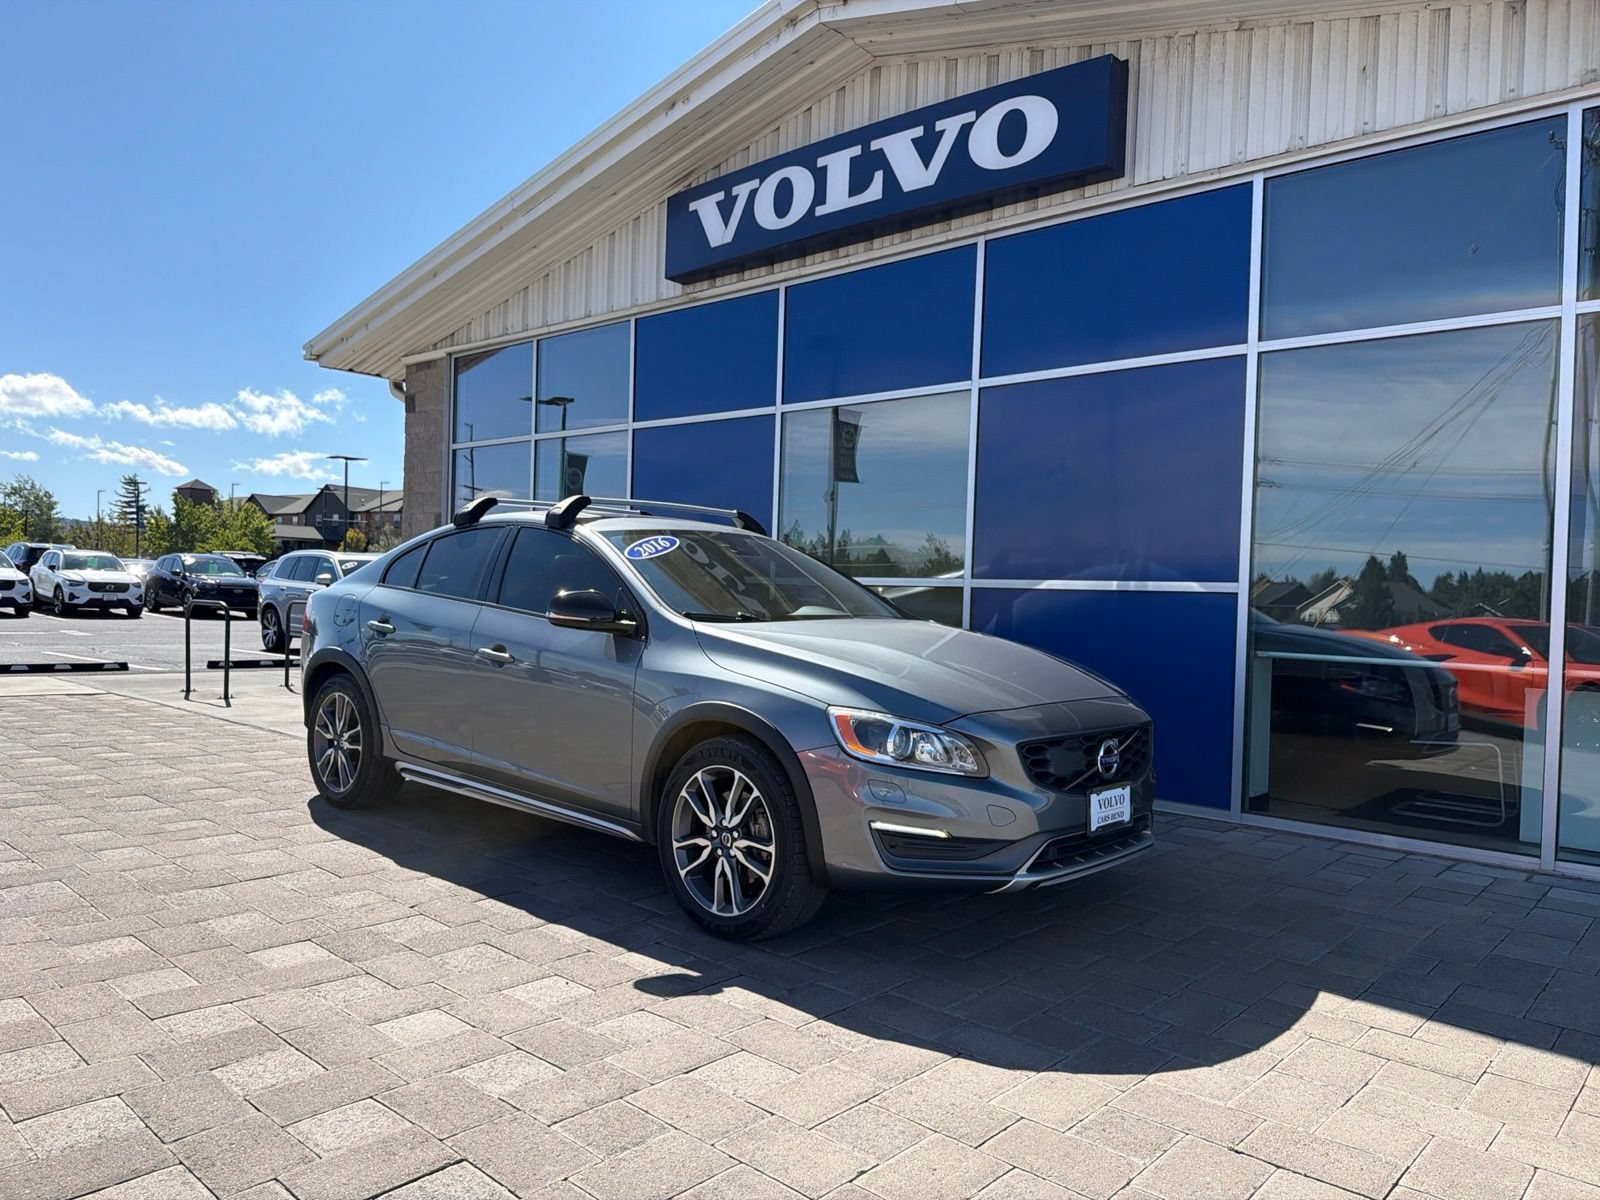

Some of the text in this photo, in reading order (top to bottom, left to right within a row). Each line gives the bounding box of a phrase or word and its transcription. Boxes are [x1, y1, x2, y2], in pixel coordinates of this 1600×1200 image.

[688, 95, 1059, 249] VOLVO
[633, 536, 671, 558] 2016
[1097, 793, 1125, 810] VOLVO
[1097, 811, 1125, 825] CARS BEND
